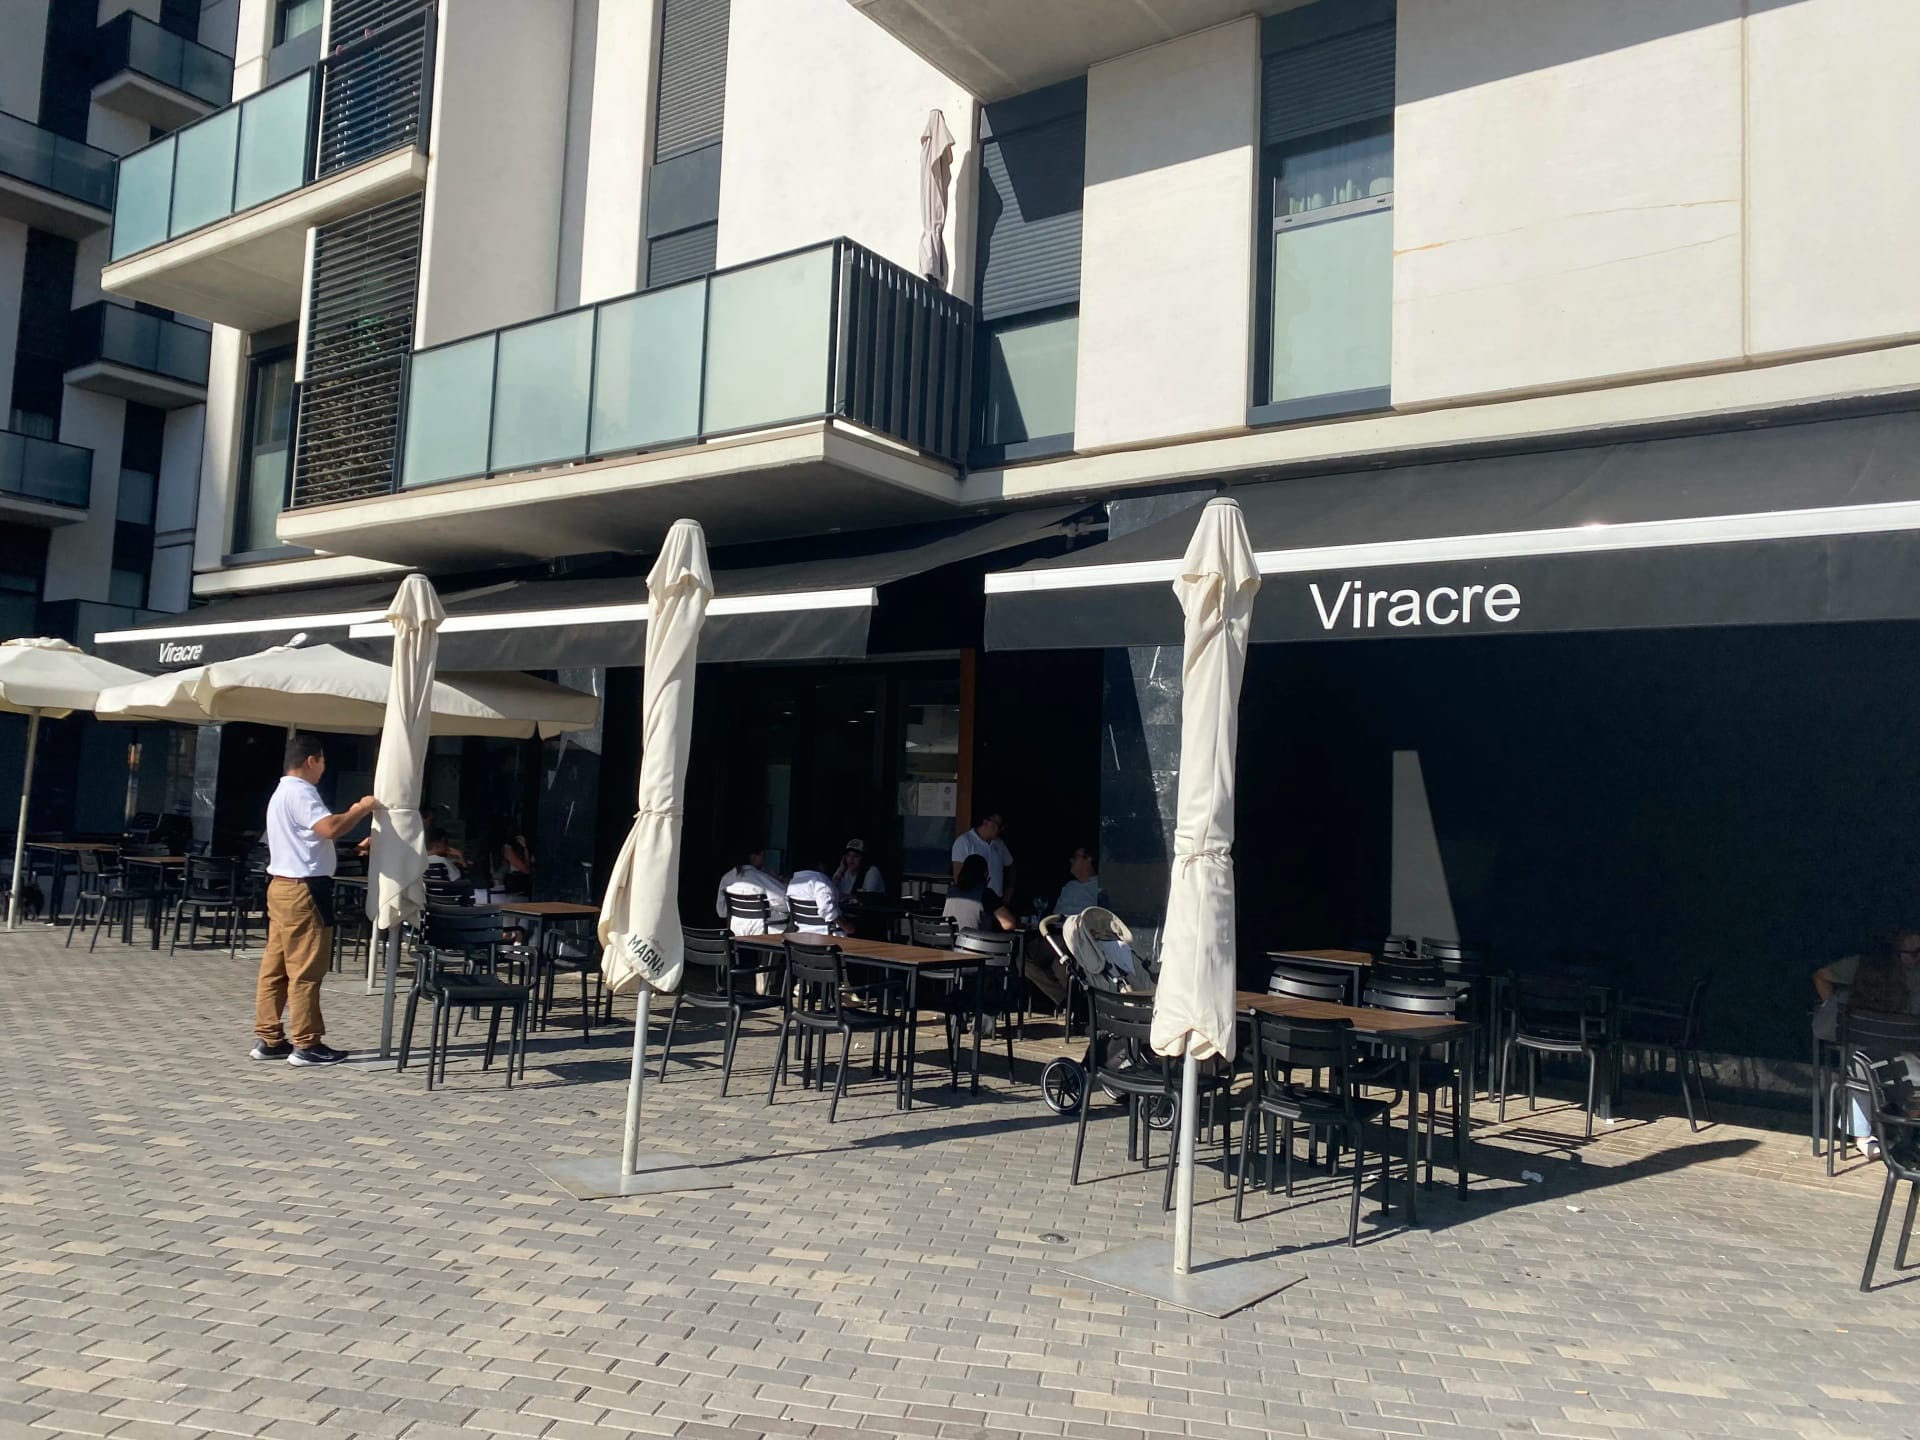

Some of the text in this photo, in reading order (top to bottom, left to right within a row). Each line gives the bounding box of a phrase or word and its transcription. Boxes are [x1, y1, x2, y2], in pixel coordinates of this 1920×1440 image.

[1309, 580, 1521, 630] Viracre
[159, 642, 203, 663] Viracre
[627, 934, 665, 976] MAGNA
